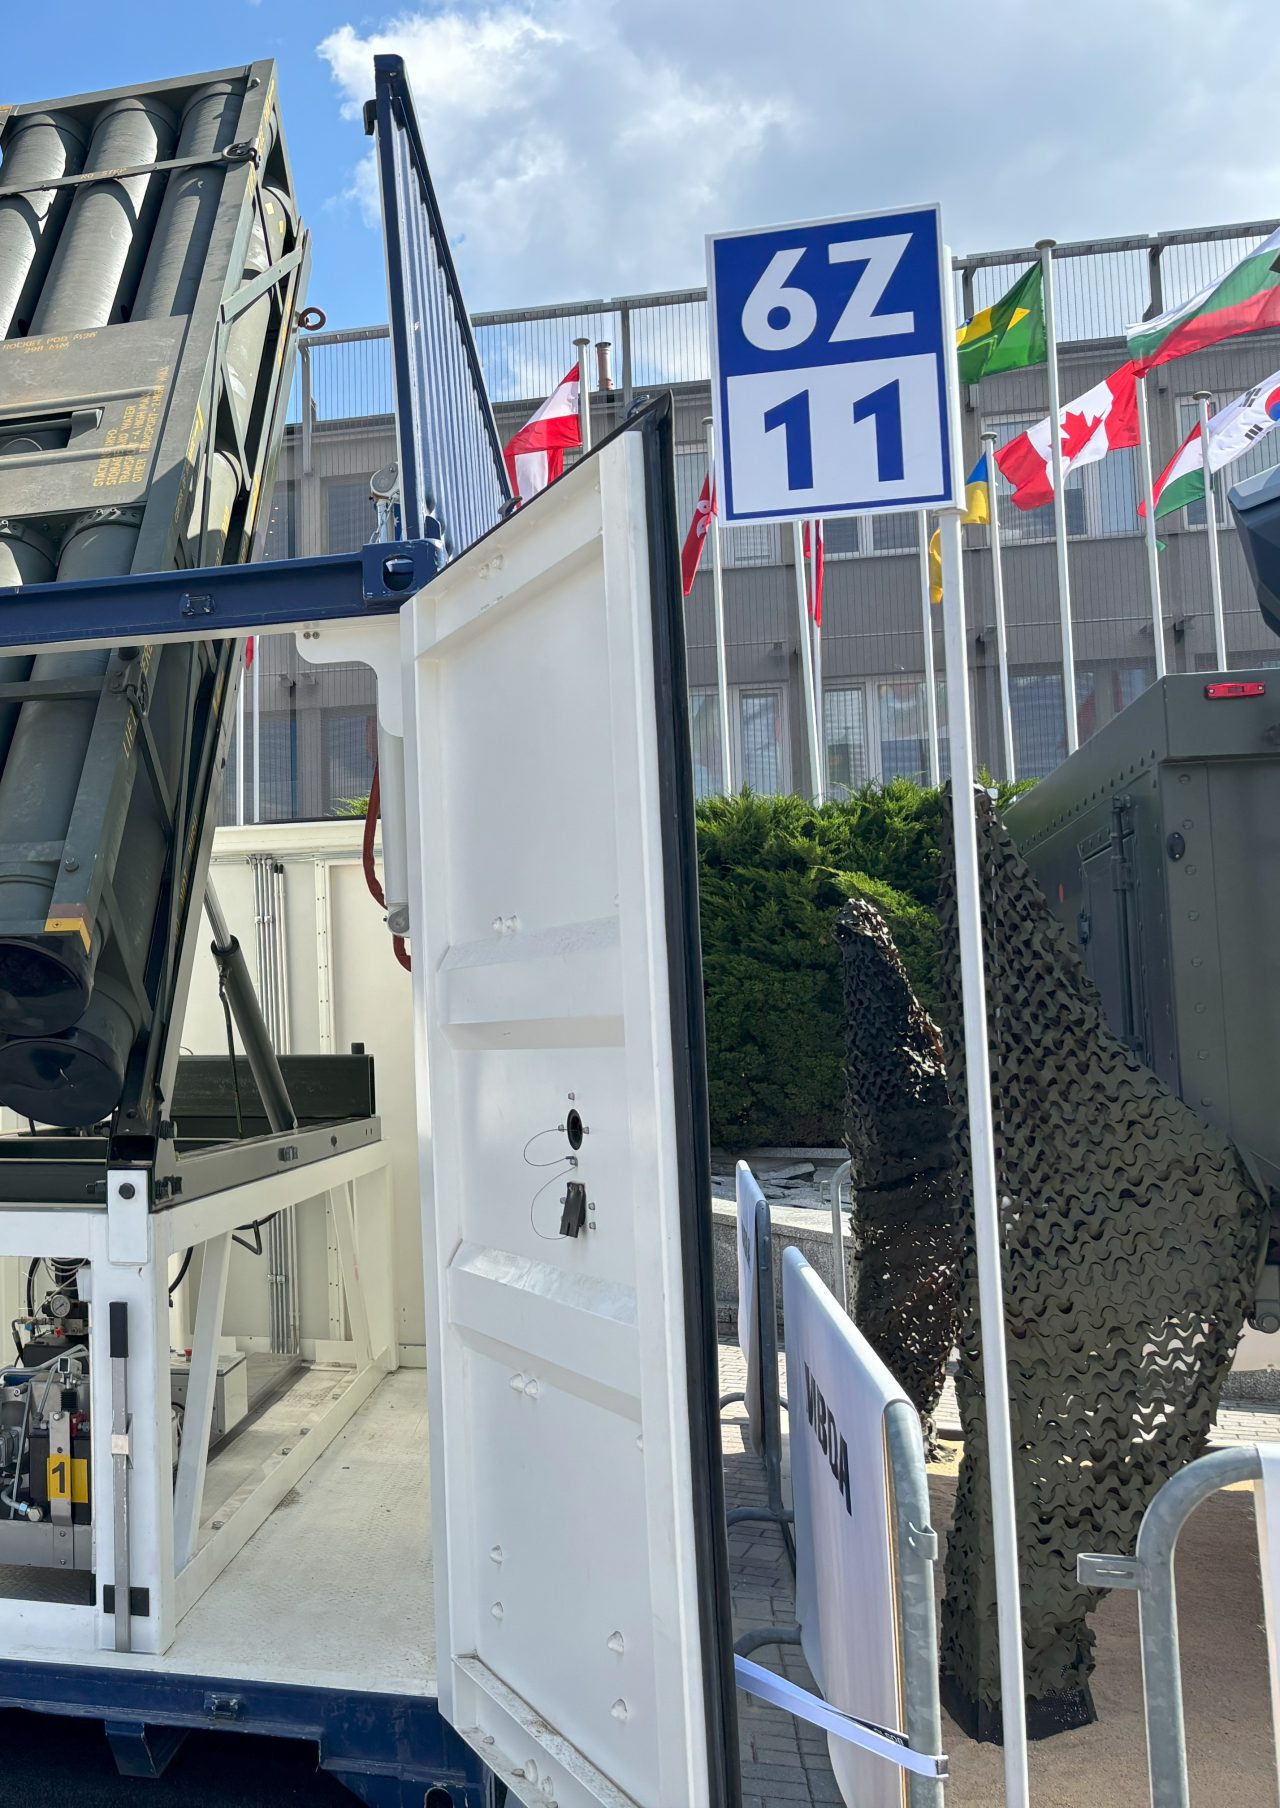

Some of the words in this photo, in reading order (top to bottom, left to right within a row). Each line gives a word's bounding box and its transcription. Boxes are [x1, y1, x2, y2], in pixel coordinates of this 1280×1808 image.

[741, 232, 915, 351] 6Z
[764, 378, 905, 491] 11
[51, 1461, 65, 1494] 1
[804, 1361, 852, 1517] MBDA
